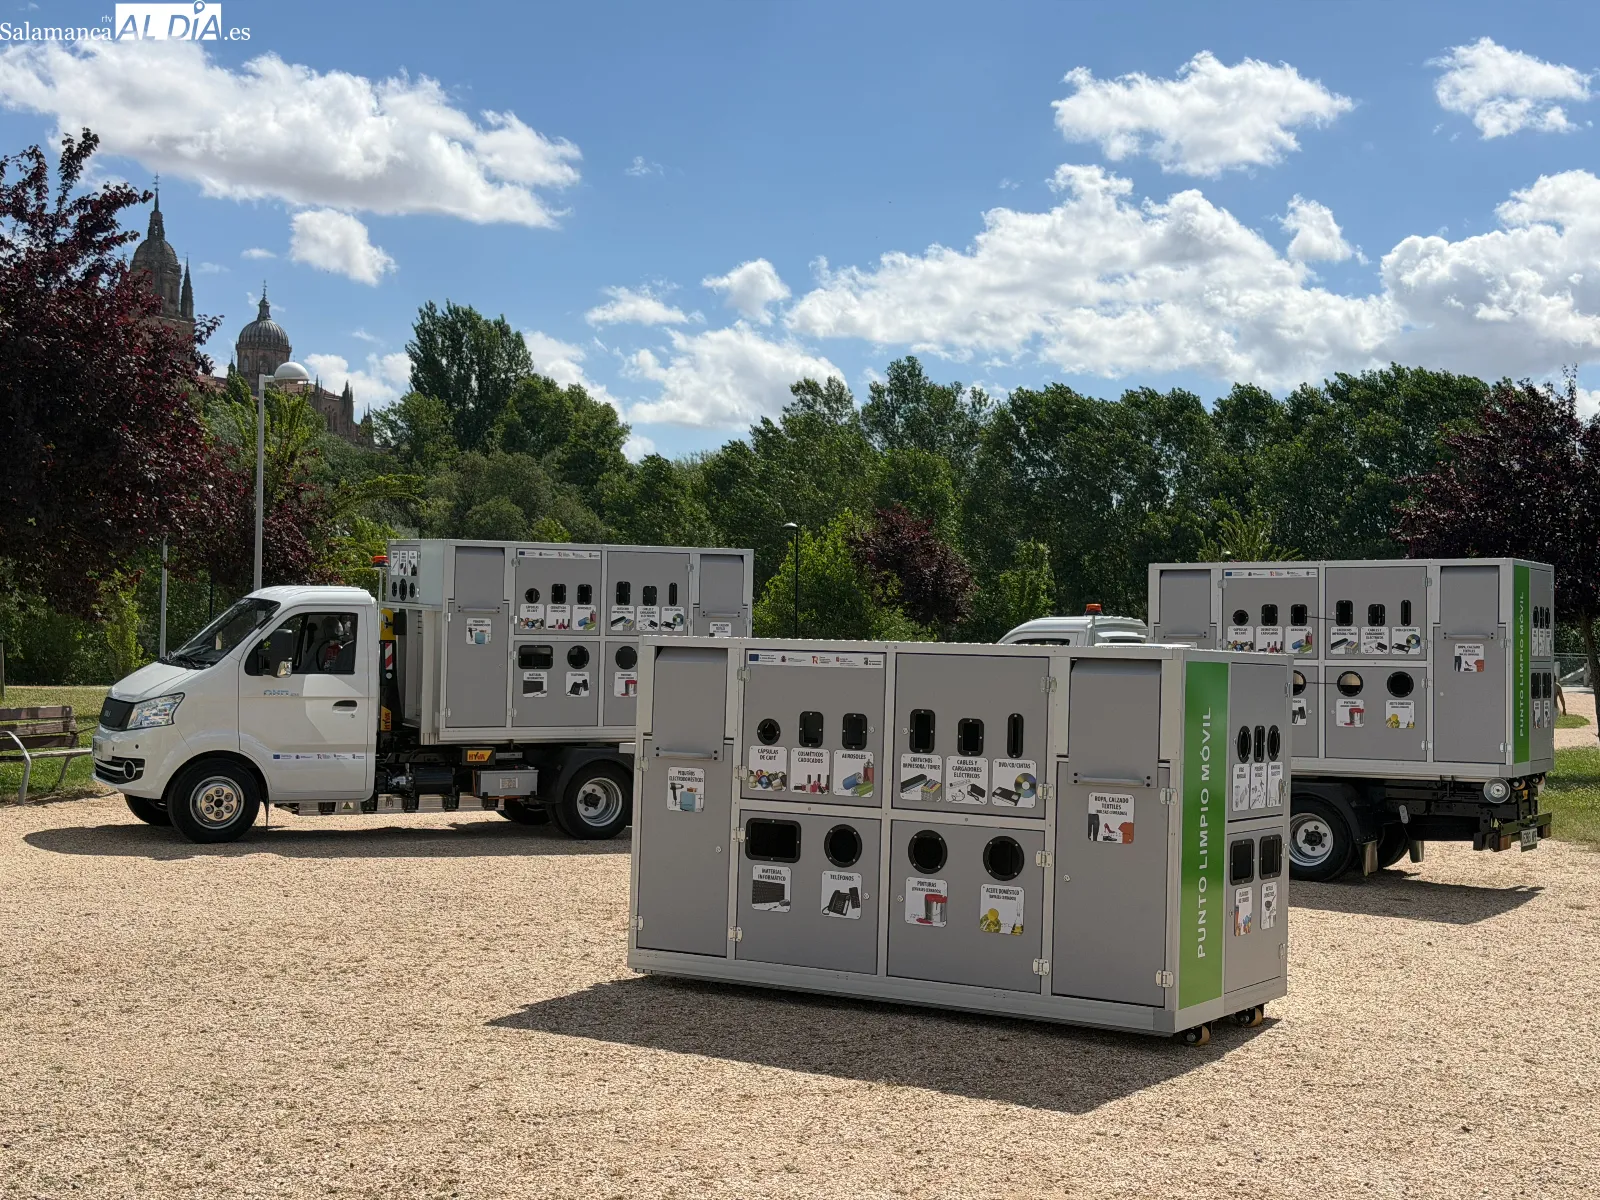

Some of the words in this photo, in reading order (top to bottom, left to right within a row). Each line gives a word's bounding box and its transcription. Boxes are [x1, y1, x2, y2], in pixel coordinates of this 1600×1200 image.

[1200, 707, 1211, 781] MÓVIL
[951, 765, 983, 773] CARGADORES
[1108, 796, 1129, 804] CALZADO
[1199, 788, 1210, 870] LIMPIO
[830, 873, 855, 881] TELÉFONOS
[1197, 876, 1208, 959] PUNTO
